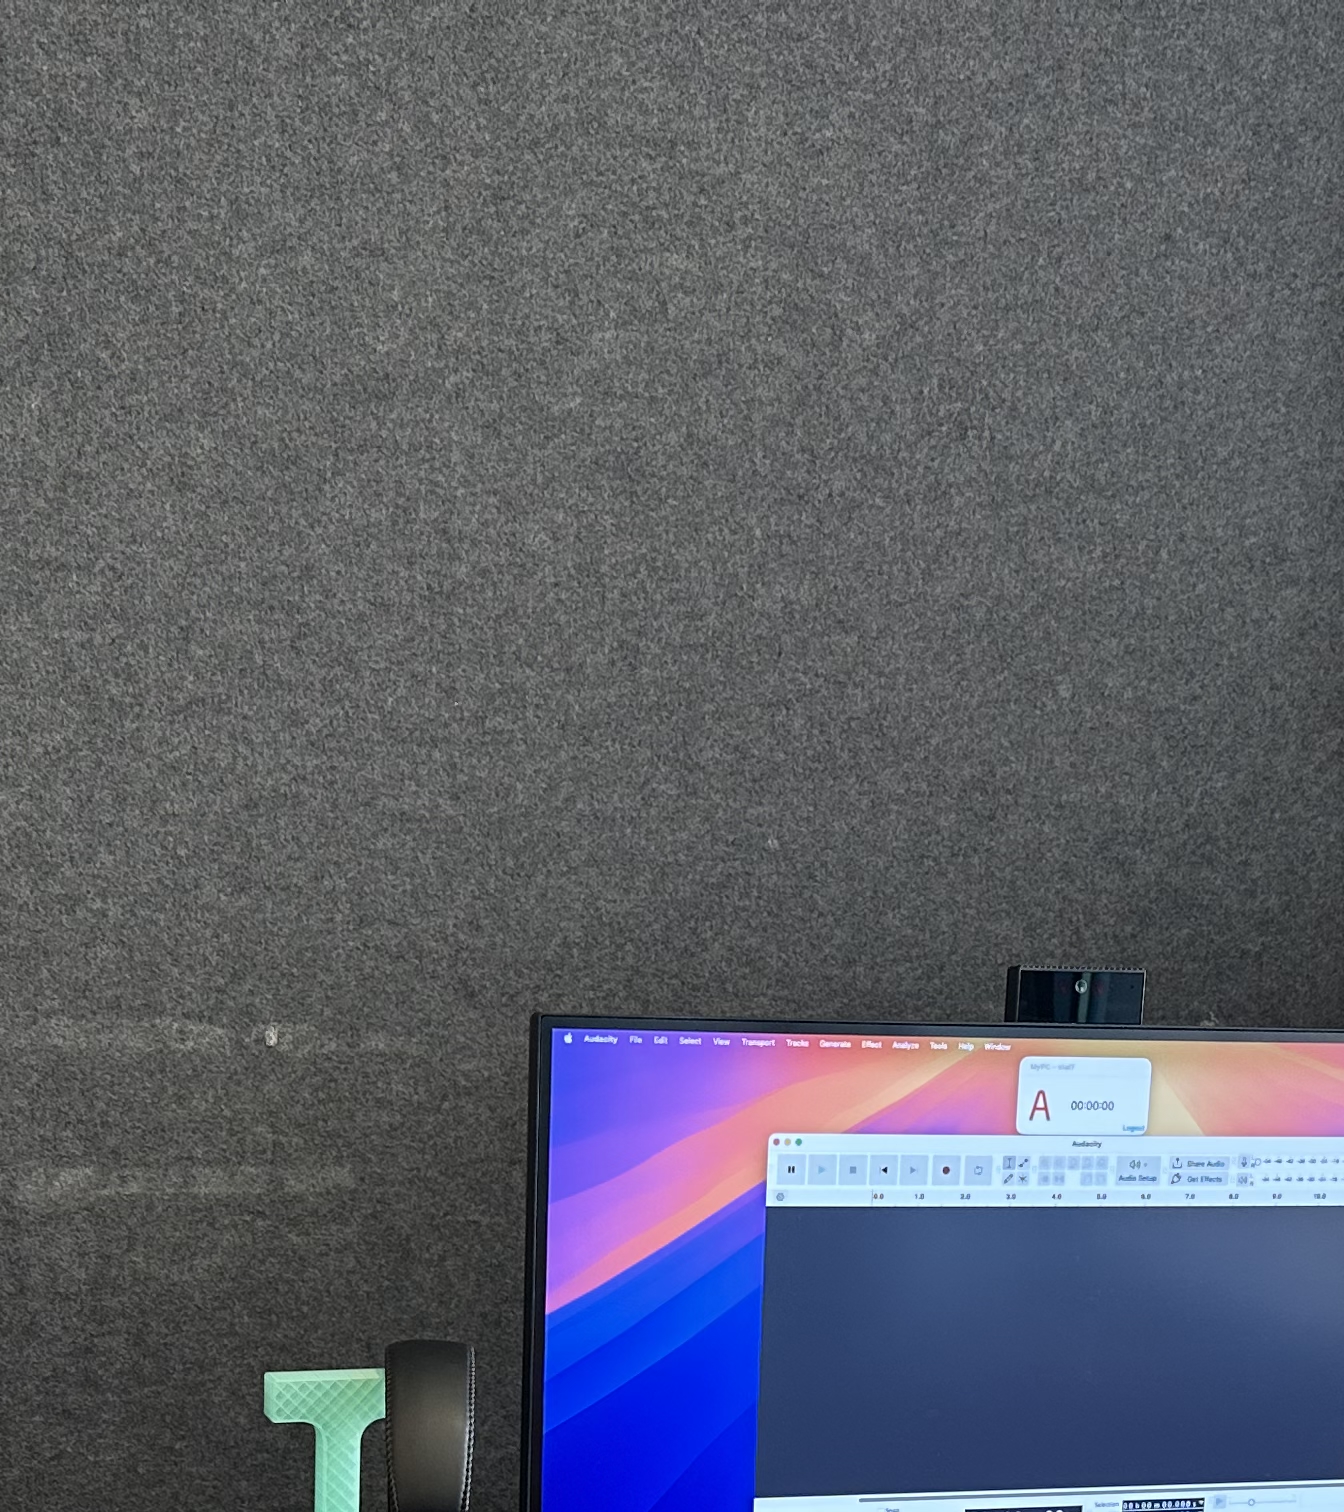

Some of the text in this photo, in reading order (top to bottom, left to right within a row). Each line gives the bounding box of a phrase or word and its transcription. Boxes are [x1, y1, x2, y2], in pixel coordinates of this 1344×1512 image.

[583, 1035, 1011, 1051] Audacity File Edit Select View Transport Tracks Generate Effect Analyze Tools Help Window
[1029, 1089, 1115, 1122] A 00:00:00
